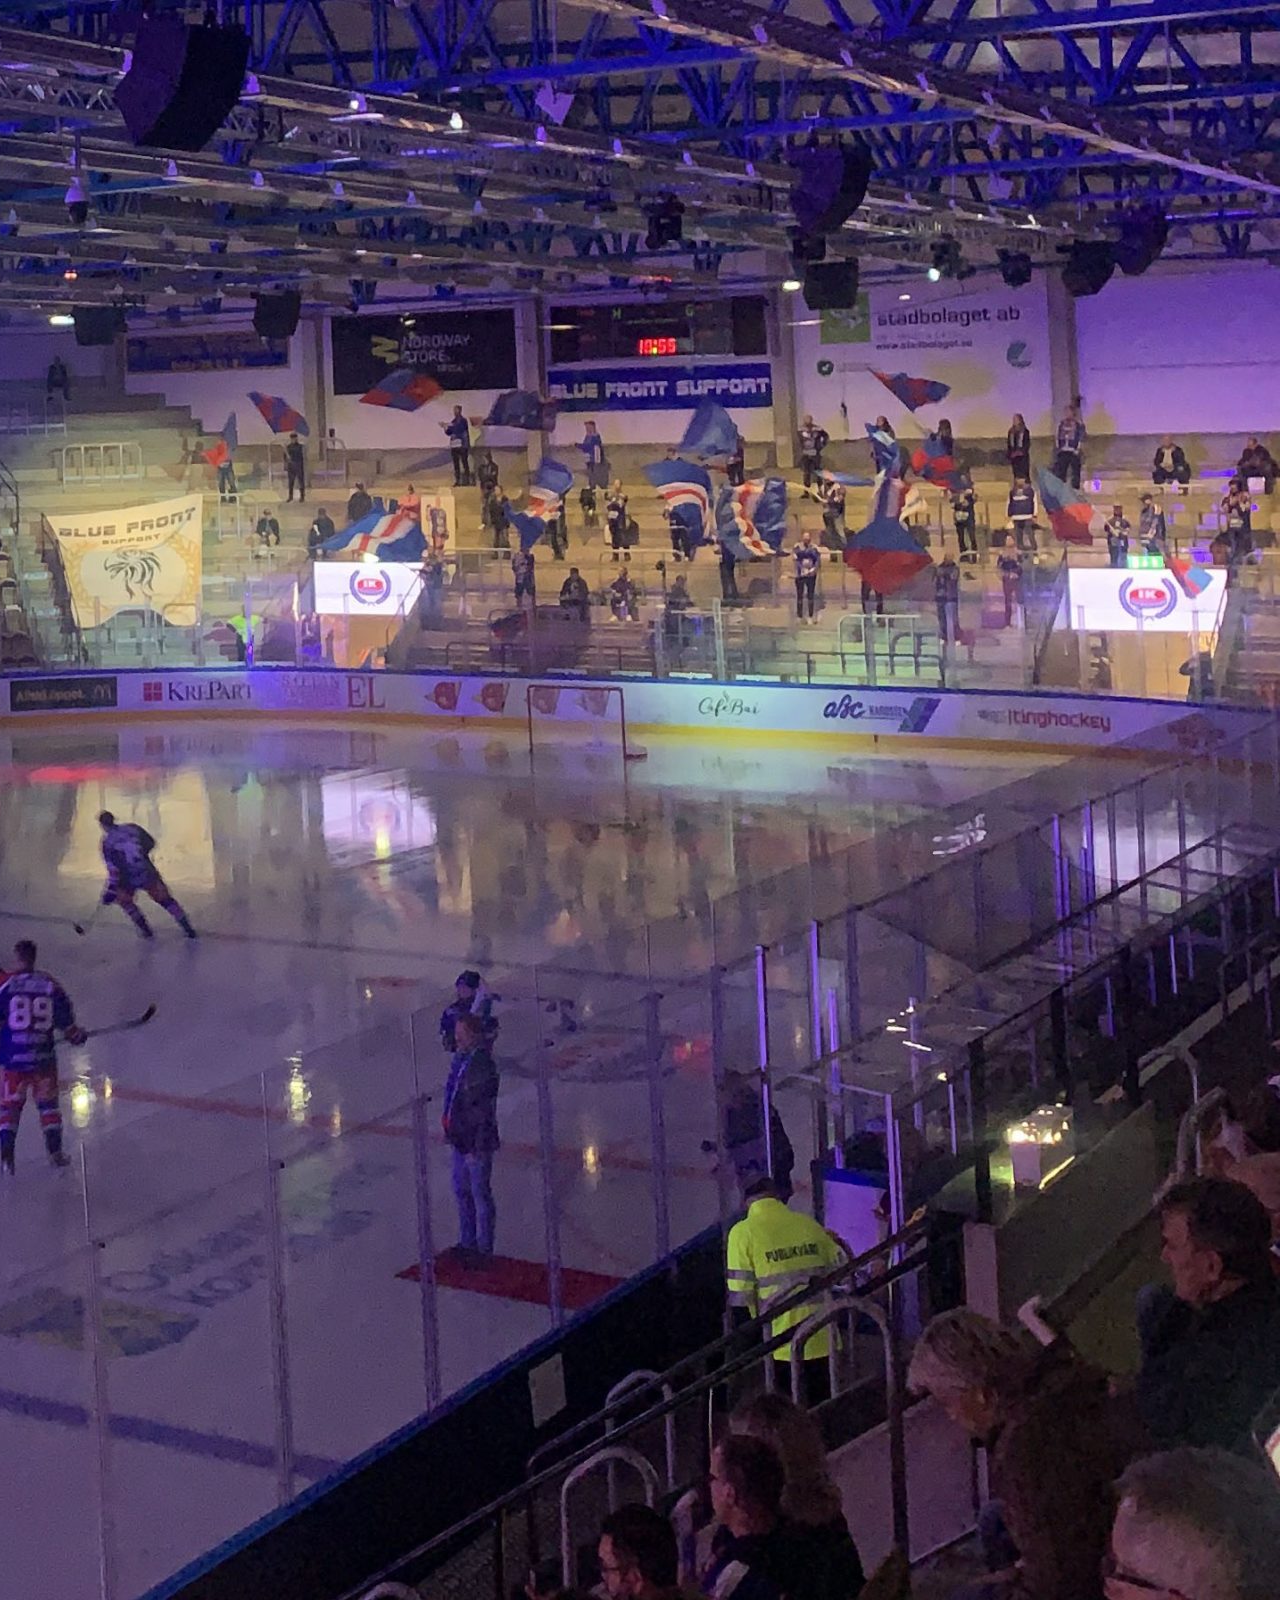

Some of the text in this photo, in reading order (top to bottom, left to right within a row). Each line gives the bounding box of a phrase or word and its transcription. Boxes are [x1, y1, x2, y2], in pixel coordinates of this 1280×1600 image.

[996, 305, 1020, 321] ab
[549, 377, 770, 400] BLUE FRONT SUPPORT
[58, 507, 196, 538] BLUE FRONT
[102, 533, 161, 545] SUPPORT
[347, 675, 386, 708] EL
[8, 995, 53, 1031] 89
